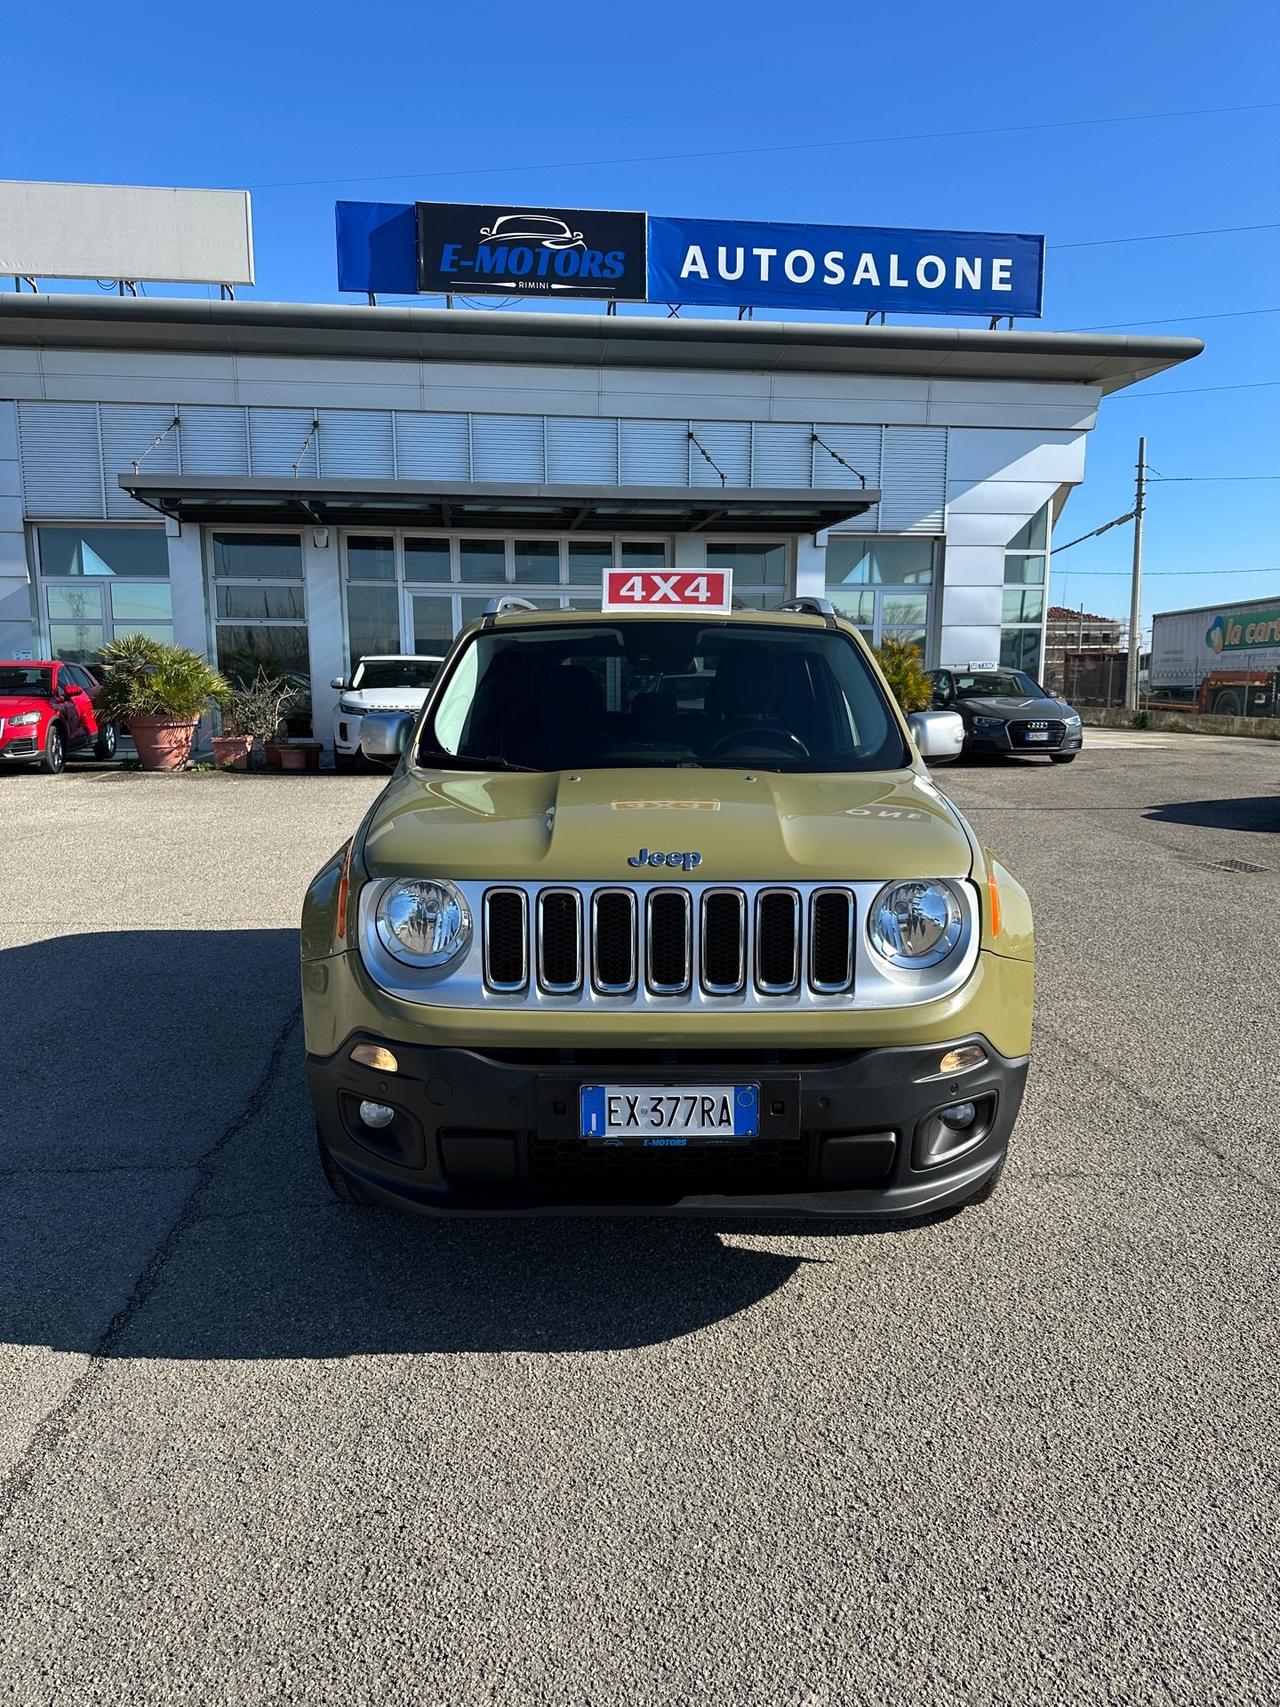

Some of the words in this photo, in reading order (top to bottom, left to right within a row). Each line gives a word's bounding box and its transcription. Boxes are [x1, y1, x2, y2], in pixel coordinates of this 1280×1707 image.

[439, 244, 626, 280] E-MOTORS
[679, 244, 1013, 292] AUTOSALONE
[518, 281, 549, 290] RIMINI
[618, 575, 711, 602] 4X4
[627, 847, 702, 872] Jeep
